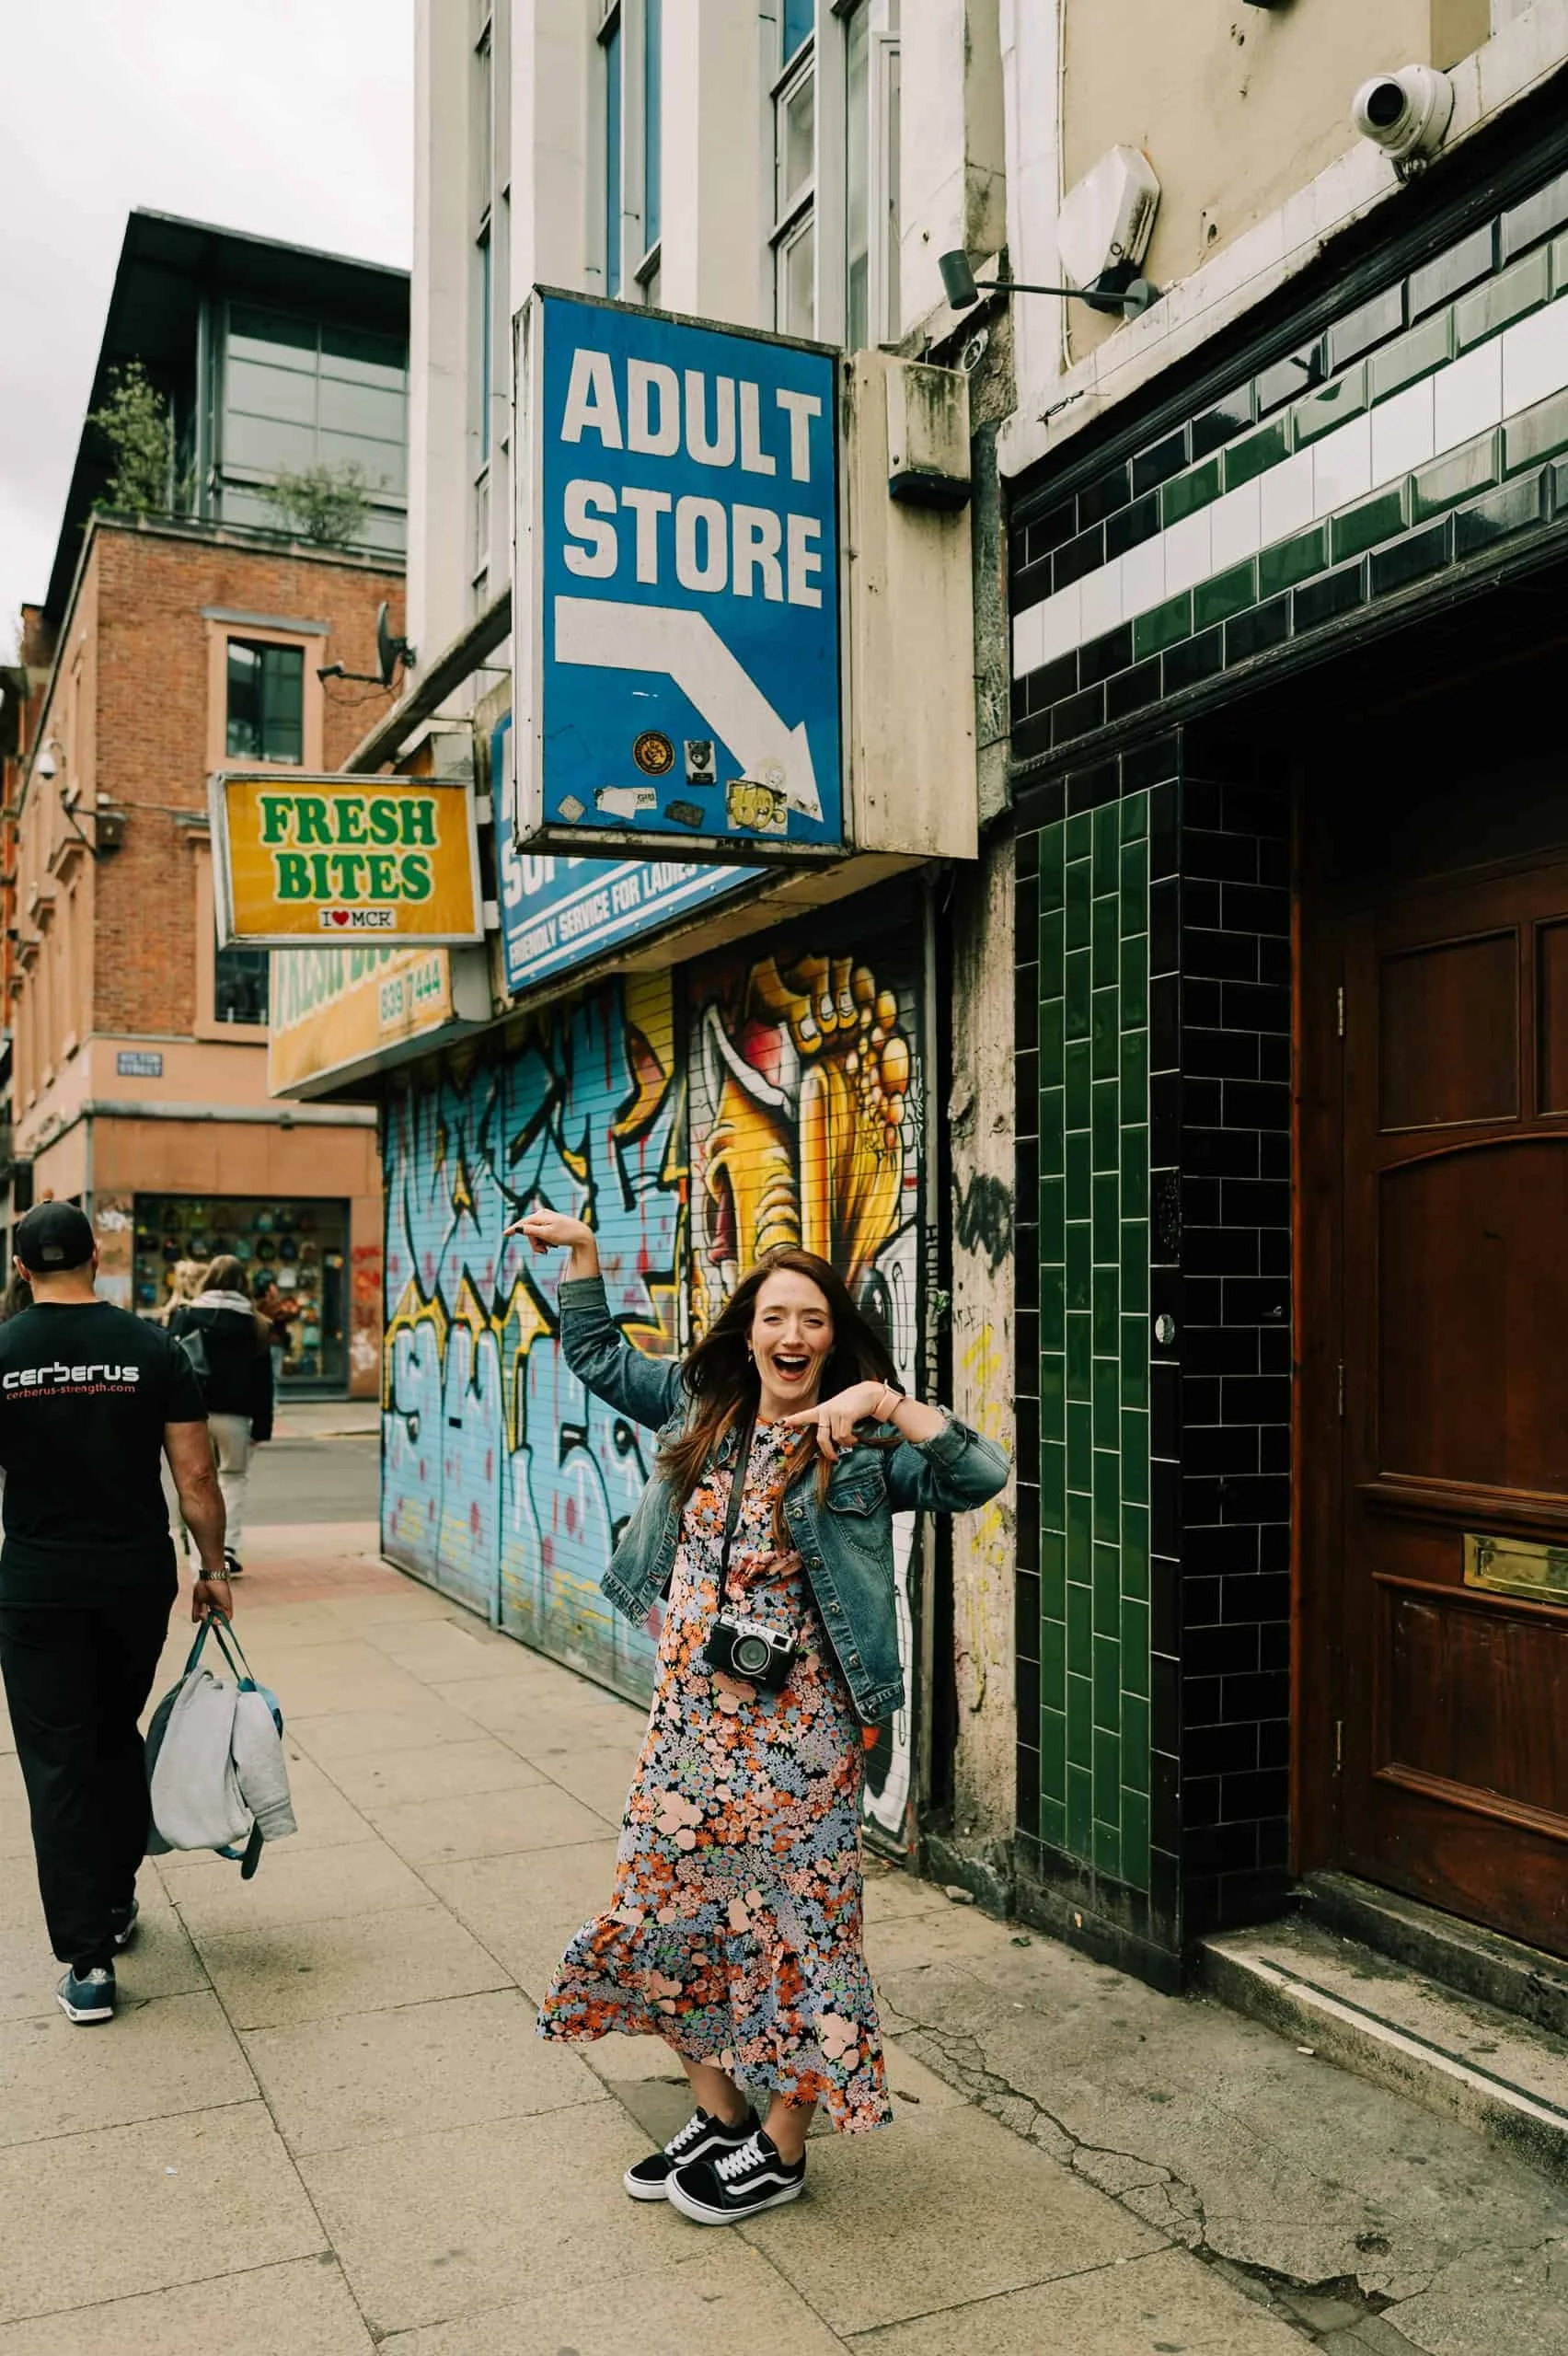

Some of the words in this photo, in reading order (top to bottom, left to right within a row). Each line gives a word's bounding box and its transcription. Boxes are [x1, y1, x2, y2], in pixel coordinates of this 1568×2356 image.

[560, 348, 822, 483] ADULT
[563, 479, 823, 608] STORE
[260, 796, 437, 846] FRESH
[275, 853, 431, 901] BITES
[323, 911, 331, 926] I
[352, 911, 392, 927] MCR
[559, 890, 610, 941] SERVICE
[611, 874, 641, 915] FOR
[2, 1361, 140, 1390] cerberus
[6, 1381, 136, 1400] cerberus-strength.com
